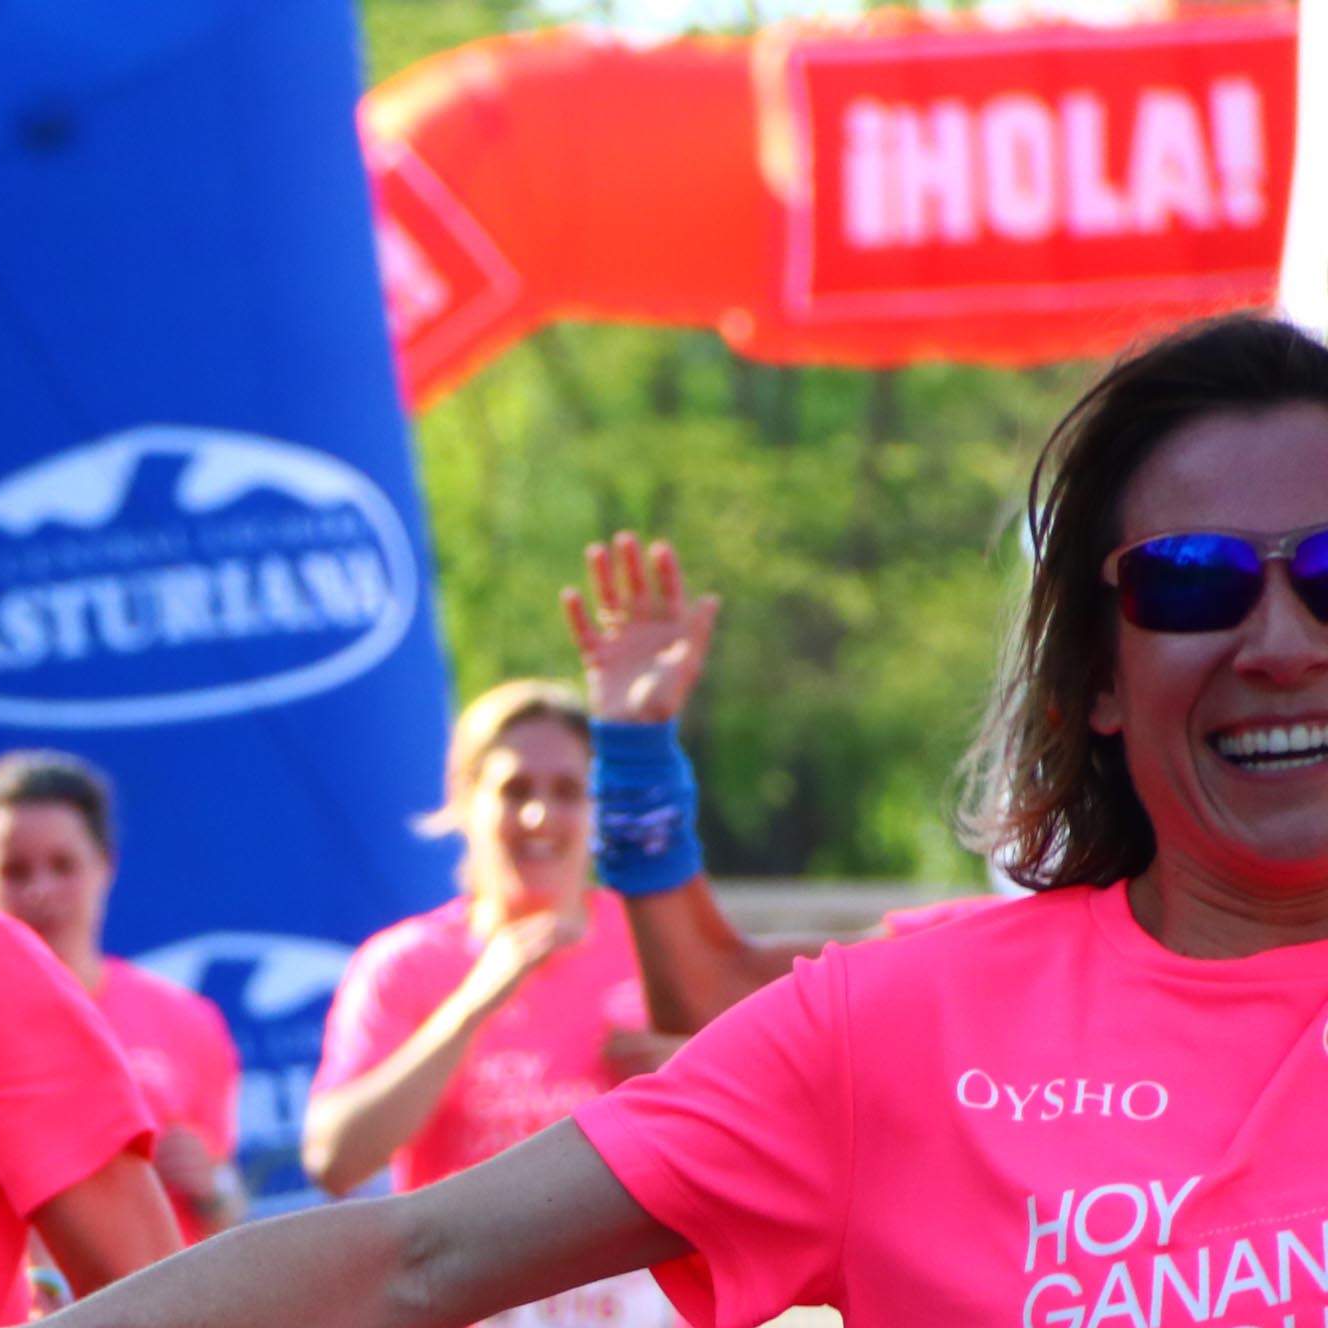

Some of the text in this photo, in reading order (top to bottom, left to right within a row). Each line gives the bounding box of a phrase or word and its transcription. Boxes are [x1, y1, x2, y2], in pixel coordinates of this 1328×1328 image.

[846, 76, 1265, 250] ¡HOLA!
[956, 1068, 1169, 1121] OYSHO
[1024, 1175, 1203, 1273] HOY
